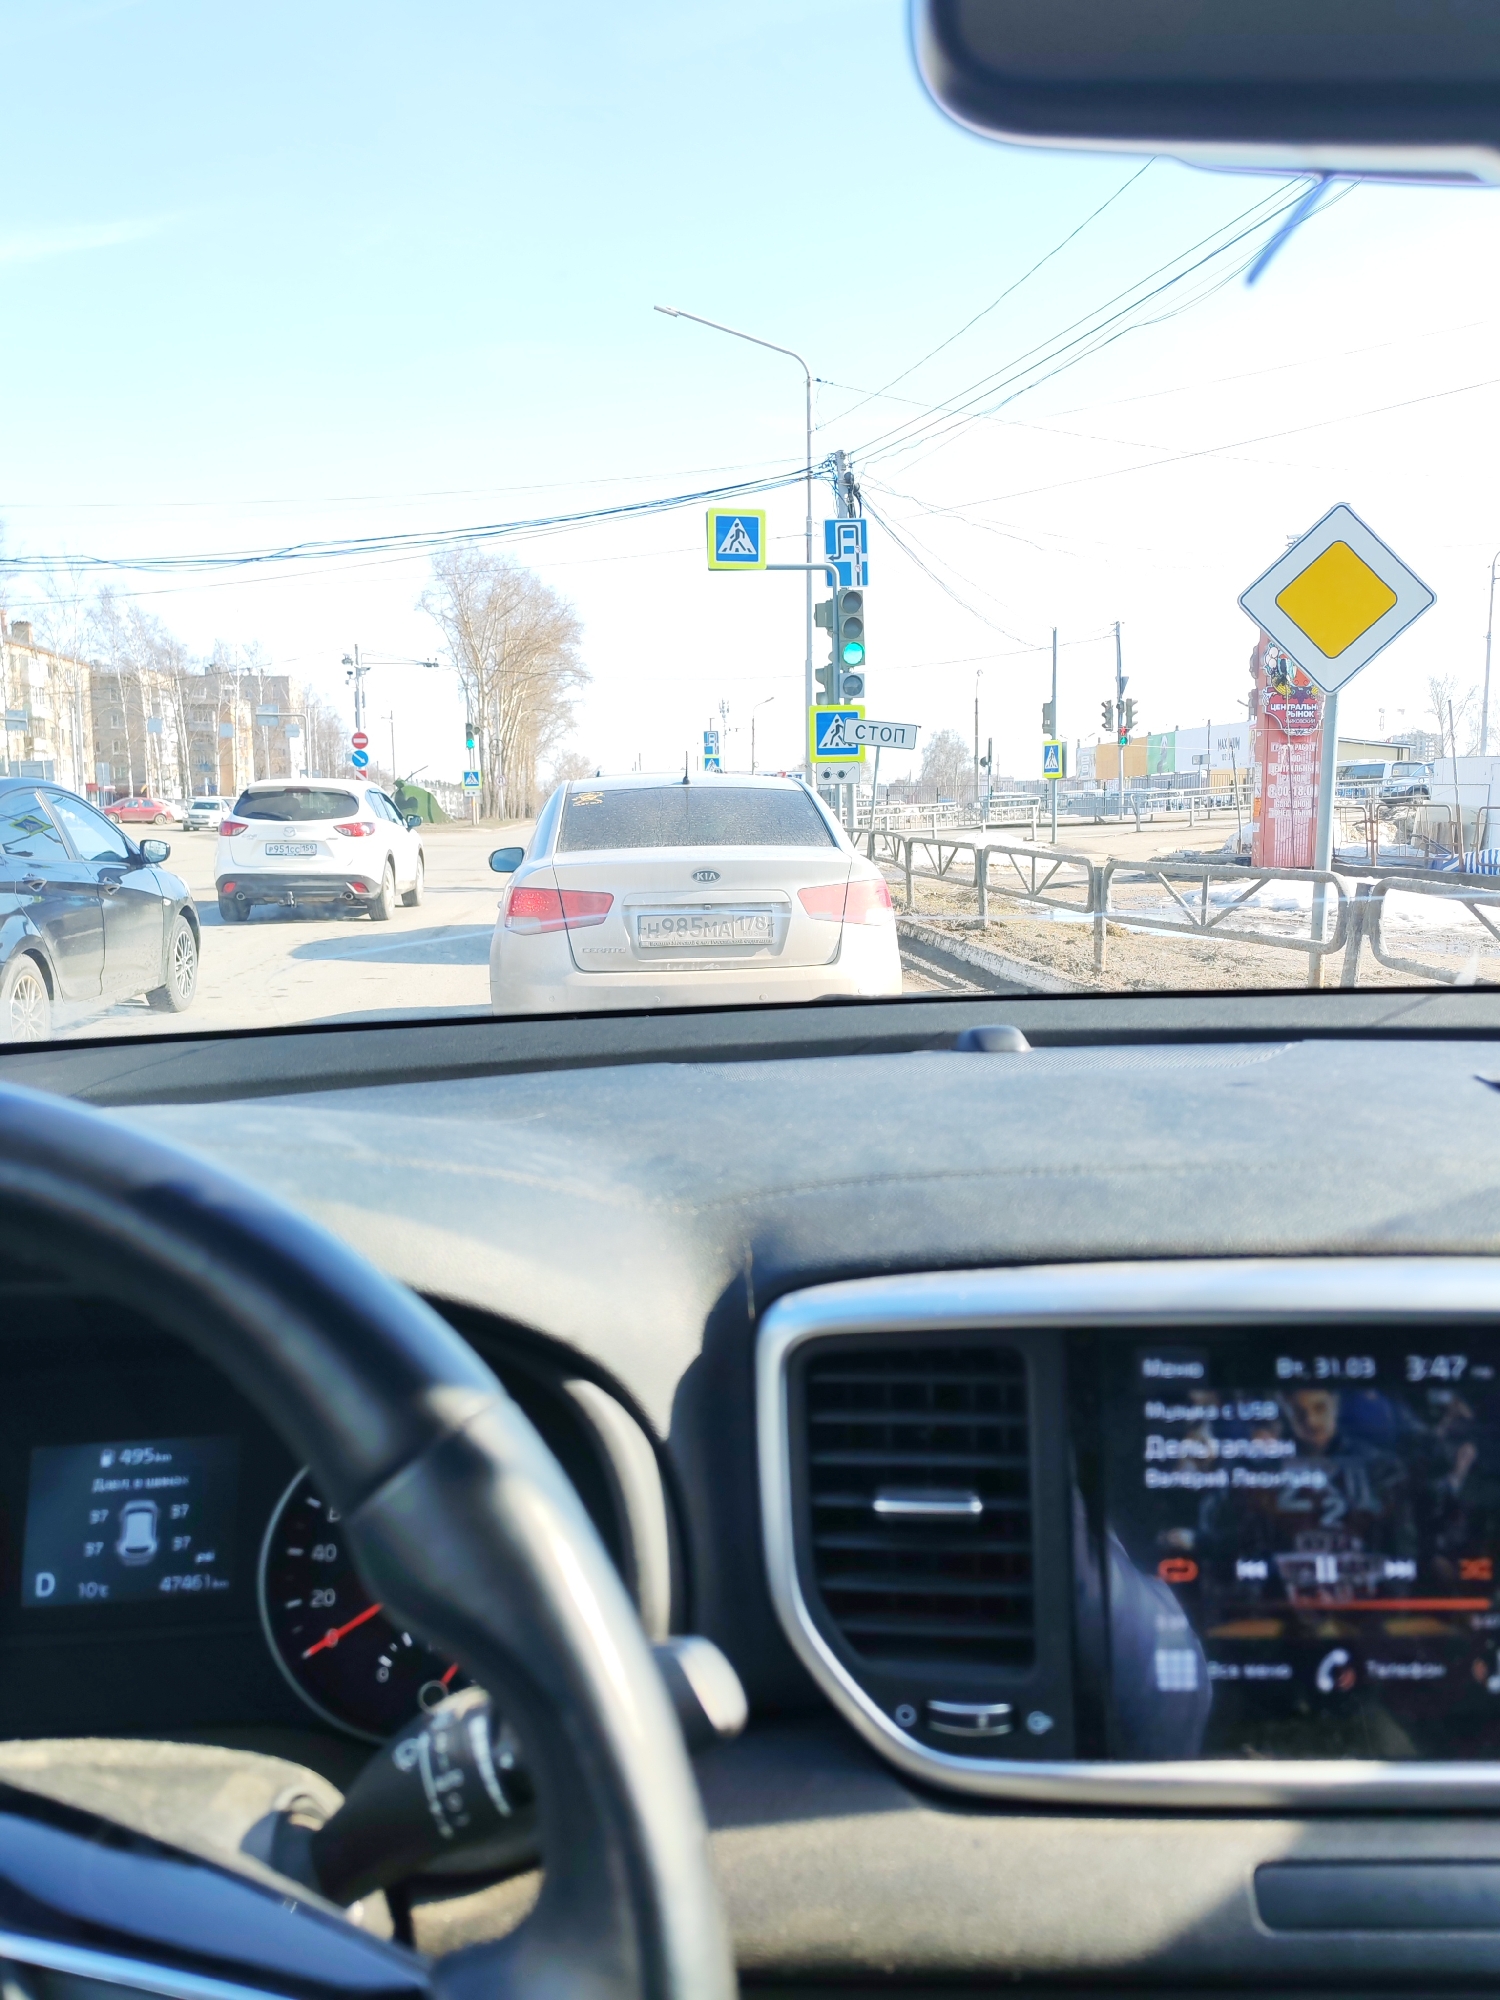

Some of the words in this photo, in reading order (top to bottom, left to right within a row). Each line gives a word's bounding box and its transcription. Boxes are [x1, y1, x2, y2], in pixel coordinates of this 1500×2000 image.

[1270, 703, 1319, 712] ЦЕНТРАЛЬН
[1286, 710, 1315, 718] РЫНОК
[854, 724, 906, 744] СТОП
[302, 844, 314, 852] 159
[696, 872, 717, 880] KIA
[647, 916, 731, 939] Н985МА
[736, 913, 768, 932] 178
[742, 930, 760, 938] RUS
[1142, 1358, 1204, 1379] Меню
[1405, 1354, 1468, 1382] 3:47
[1145, 1401, 1220, 1423] Музыка
[1237, 1401, 1279, 1421] USB
[1145, 1434, 1297, 1462] Дельтаплан
[89, 1508, 110, 1525] 37
[170, 1503, 190, 1520] 37
[83, 1541, 105, 1558] 37
[171, 1535, 192, 1552] 37
[310, 1543, 338, 1563] 40
[35, 1571, 56, 1598] D
[310, 1587, 337, 1608] 20
[1243, 1661, 1293, 1680] меню
[1365, 1659, 1446, 1681] Телефон
